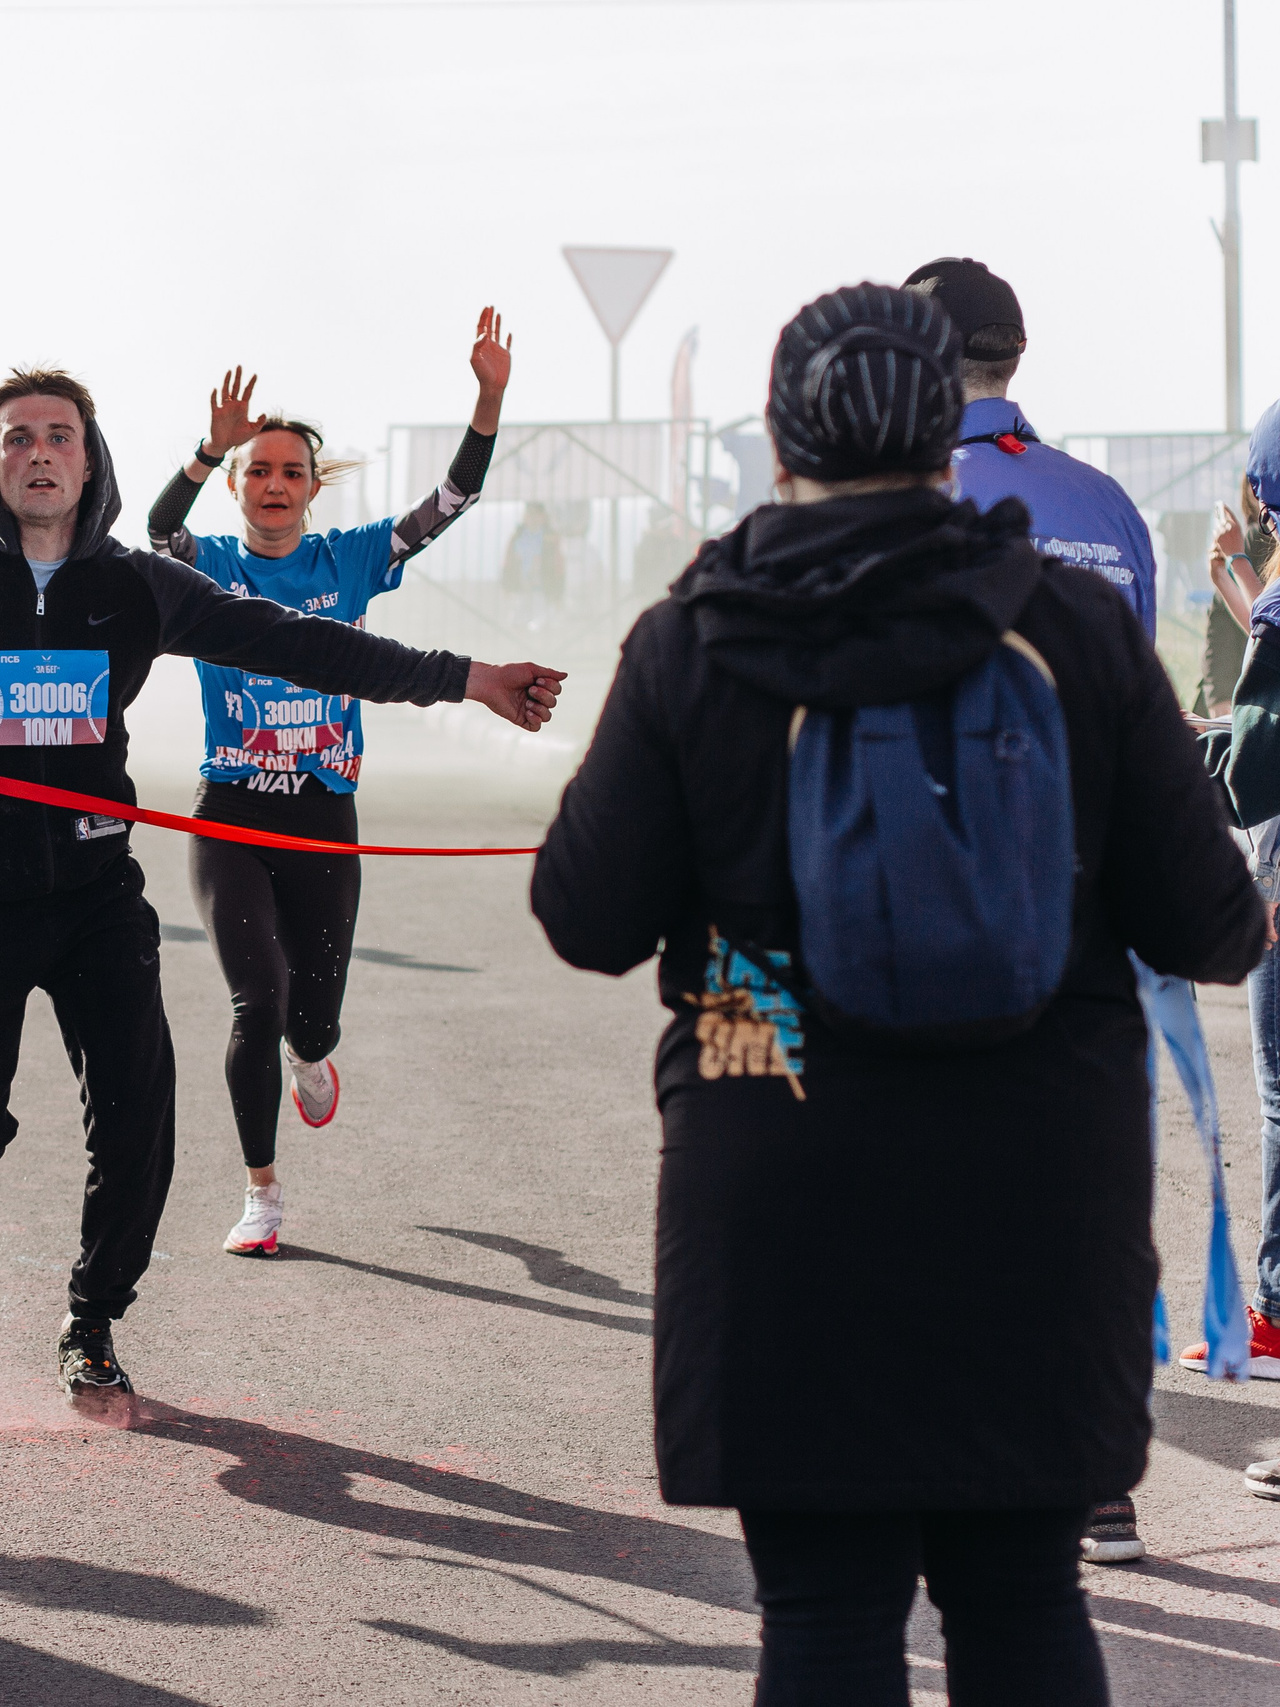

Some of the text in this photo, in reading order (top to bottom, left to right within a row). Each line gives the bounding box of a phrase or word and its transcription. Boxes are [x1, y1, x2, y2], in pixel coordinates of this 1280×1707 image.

[0, 655, 20, 664] ПСБ
[257, 678, 273, 686] ПСБ
[9, 682, 87, 714] 30006
[264, 697, 323, 726] 30001
[1095, 1504, 1130, 1515] adidas
